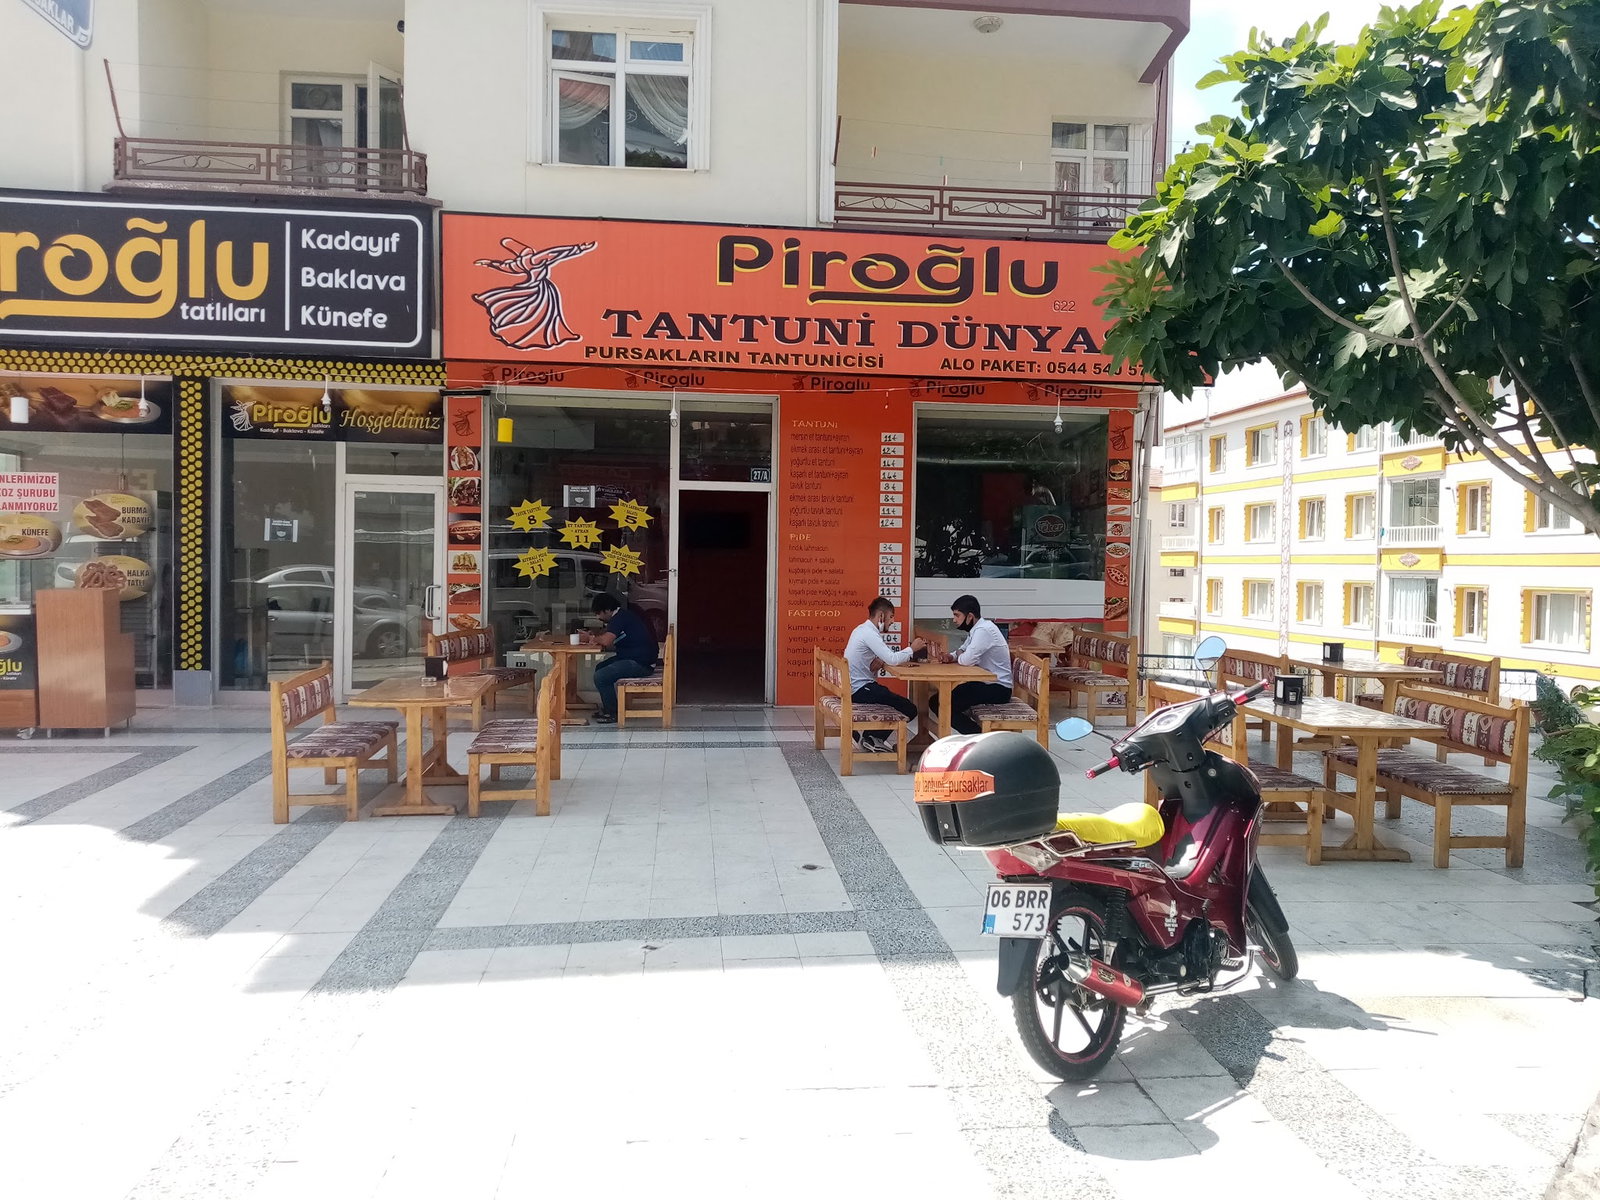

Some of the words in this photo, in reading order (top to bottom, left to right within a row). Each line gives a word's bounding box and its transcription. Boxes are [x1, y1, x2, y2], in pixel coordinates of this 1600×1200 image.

[301, 228, 400, 257] Kadayıf
[301, 266, 406, 292] Baklava
[716, 234, 1060, 306] Piroğlu
[180, 302, 266, 323] tatlıları
[1053, 301, 1076, 312] 622
[301, 304, 388, 329] Künefe
[602, 308, 876, 348] TANTUNİ
[897, 315, 1110, 356] DÜNYA
[584, 345, 739, 365] PURSAKLARIN
[940, 358, 975, 370] ALO
[981, 359, 1041, 373] PAKET:
[1046, 361, 1087, 374] 0544
[339, 407, 441, 434] Hoşgeldiniz
[753, 471, 768, 480] 27/A
[17, 488, 55, 499] ŞURUBU
[0, 502, 58, 511] ANMIYORUZ
[528, 515, 537, 525] 8
[624, 515, 638, 524] 5
[21, 527, 49, 536] KÜNEFE
[613, 561, 627, 572] 12
[991, 890, 1010, 908] 06
[1015, 889, 1048, 909] BRR
[1012, 913, 1044, 931] 573
